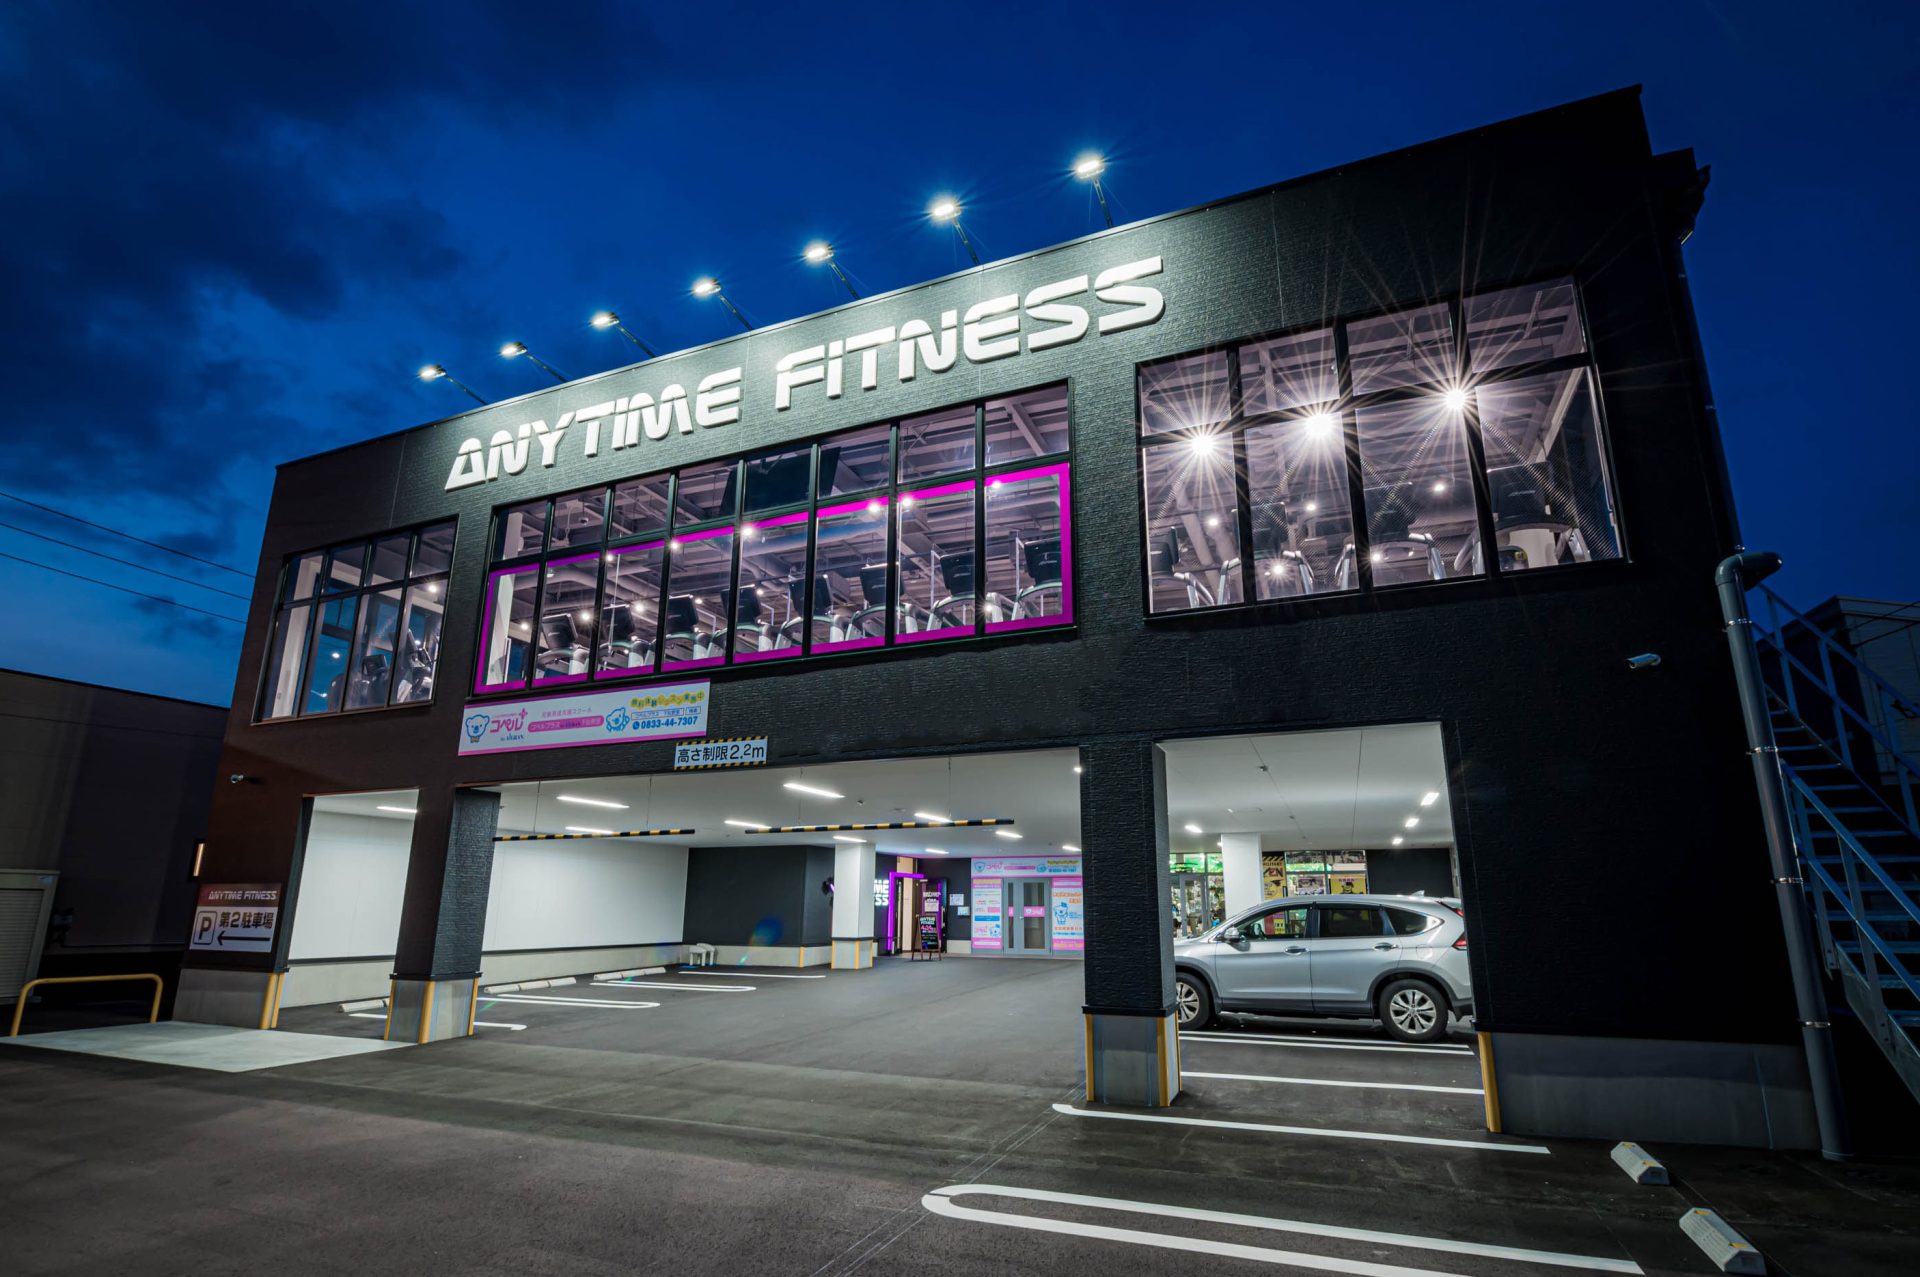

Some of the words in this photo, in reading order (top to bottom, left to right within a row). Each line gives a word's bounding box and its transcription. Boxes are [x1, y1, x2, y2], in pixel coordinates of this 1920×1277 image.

[444, 366, 742, 492] ANYTIME
[775, 255, 1166, 411] FITNESS
[641, 716, 698, 729] 0833-44-7307
[677, 743, 765, 764] 高さ制限2.2m
[208, 890, 243, 900] ANYTIME
[243, 890, 277, 900] FITNESS
[199, 917, 211, 940] P
[219, 911, 274, 929] 第2駐車場
